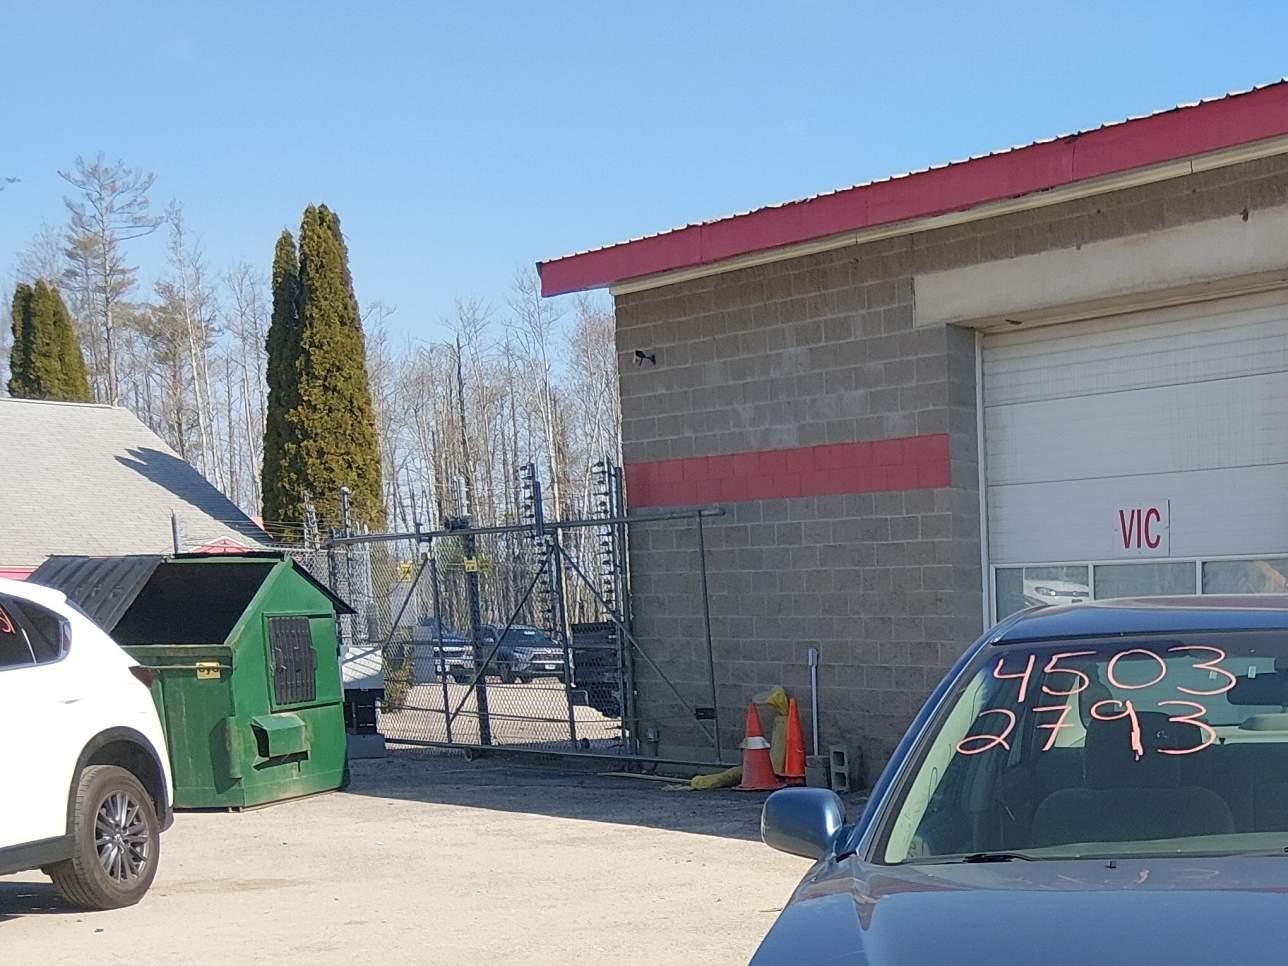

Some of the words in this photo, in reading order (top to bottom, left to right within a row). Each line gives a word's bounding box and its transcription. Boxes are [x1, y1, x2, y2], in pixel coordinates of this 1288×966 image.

[1119, 507, 1161, 549] VIC
[993, 645, 1237, 703] 4503
[956, 700, 1217, 761] 2793
